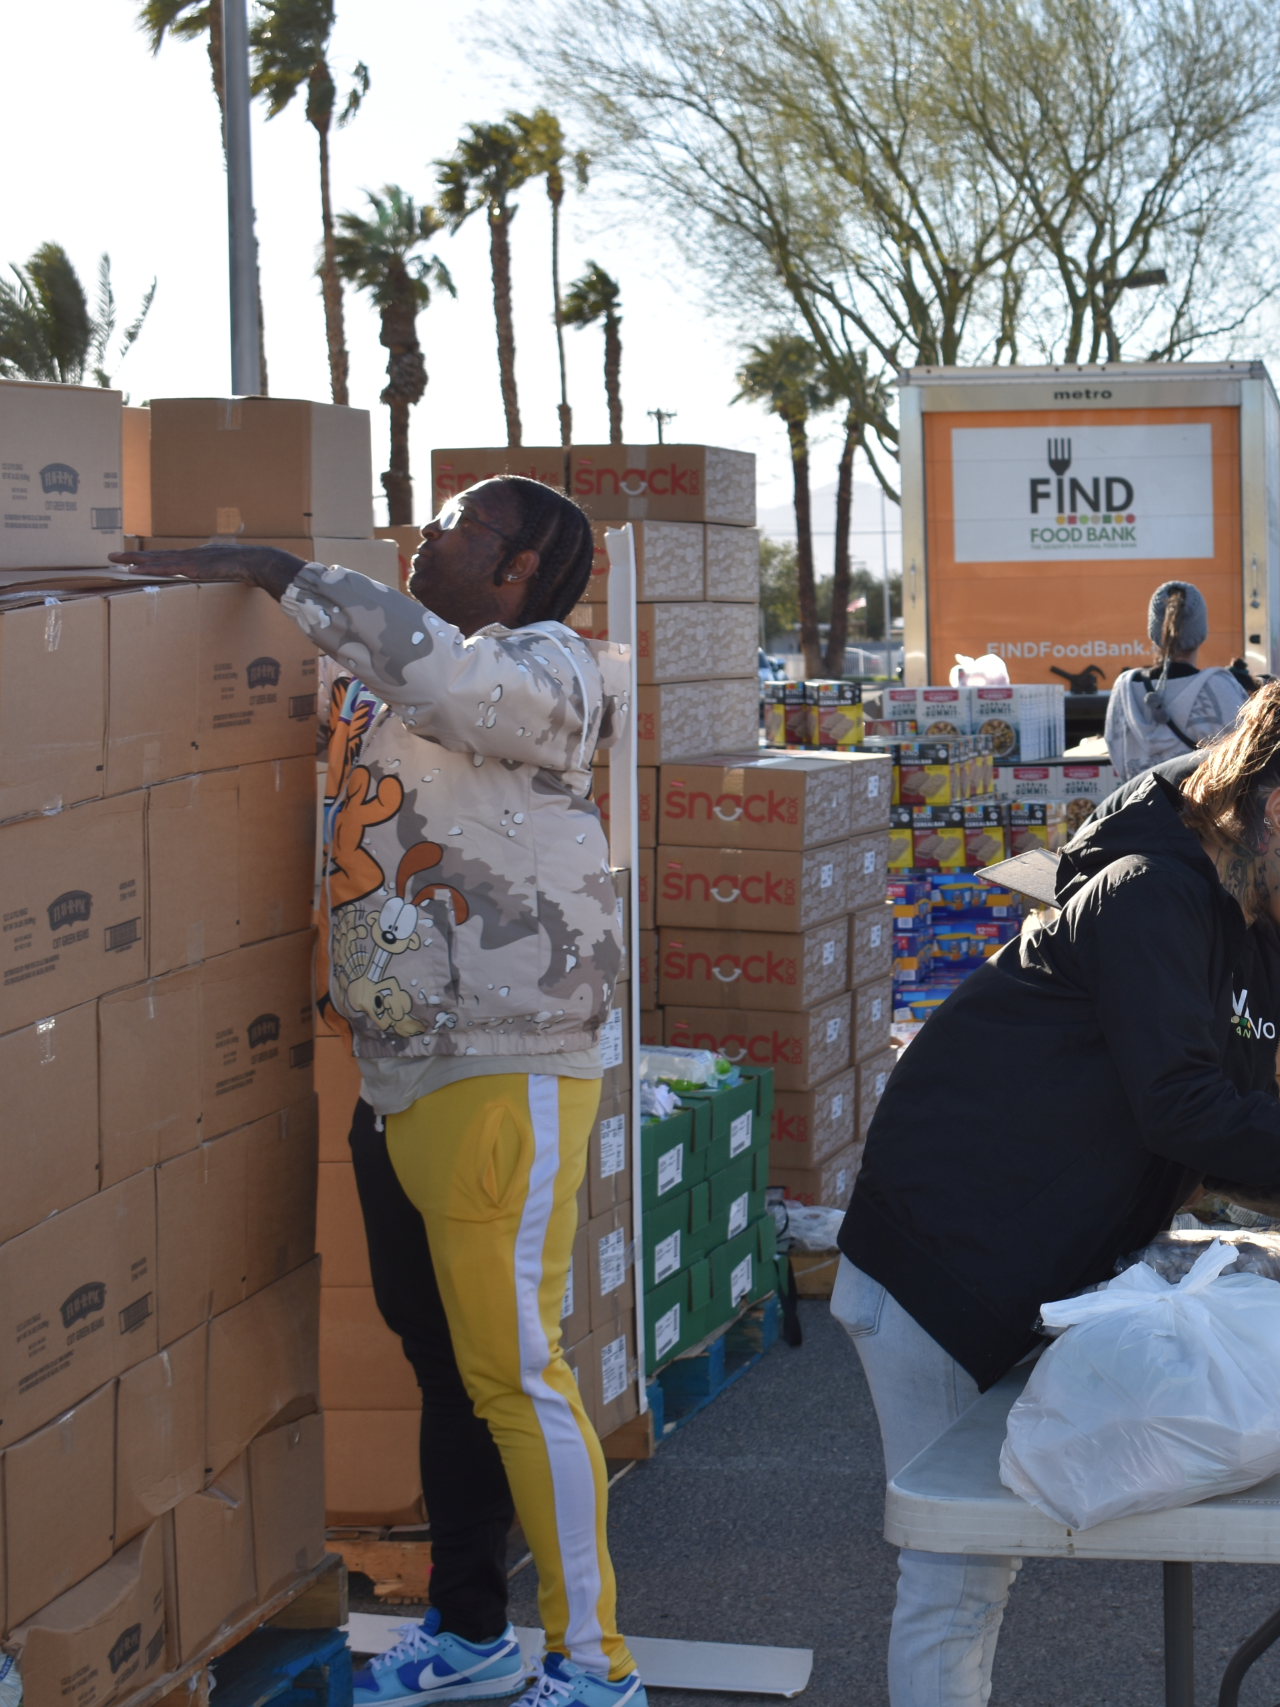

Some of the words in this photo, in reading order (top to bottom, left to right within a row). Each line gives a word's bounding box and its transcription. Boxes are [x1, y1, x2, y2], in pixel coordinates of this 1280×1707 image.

[1053, 389, 1113, 400] metro
[574, 463, 690, 496] snack
[688, 468, 700, 496] BOX
[1030, 477, 1134, 514] FIND
[1030, 527, 1082, 543] FOOD
[1087, 526, 1136, 542] BANK
[639, 630, 650, 658] BOX
[643, 712, 655, 740] BOX
[664, 790, 786, 824] snack
[786, 796, 799, 824] BOX
[662, 871, 784, 904] snack
[783, 878, 796, 906] BOX
[663, 951, 785, 984] snack
[784, 957, 798, 986] BOX
[791, 1037, 803, 1065] BOX
[796, 1116, 808, 1142] BOX
